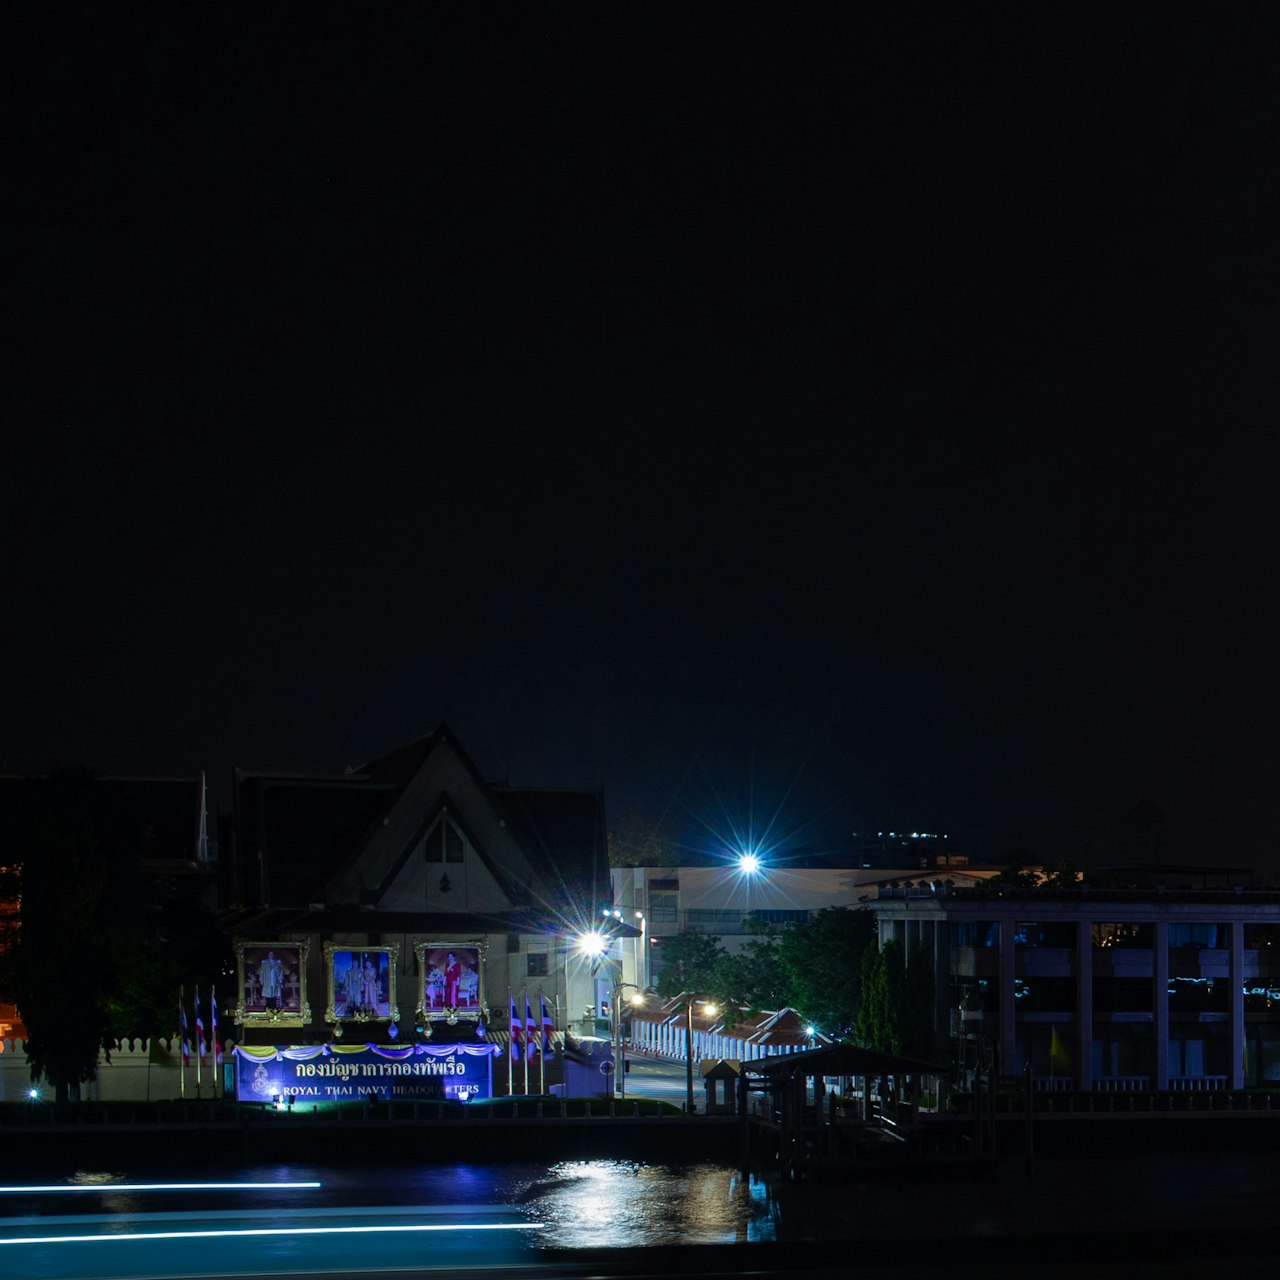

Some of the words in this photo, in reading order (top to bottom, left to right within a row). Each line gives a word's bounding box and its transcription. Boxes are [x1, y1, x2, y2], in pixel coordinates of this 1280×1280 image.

[295, 1055, 466, 1081] กองบัญชาการกองทัพเรือ
[283, 1086, 321, 1095] ROYAL
[325, 1086, 353, 1095] THAI
[357, 1085, 388, 1095] NAVY
